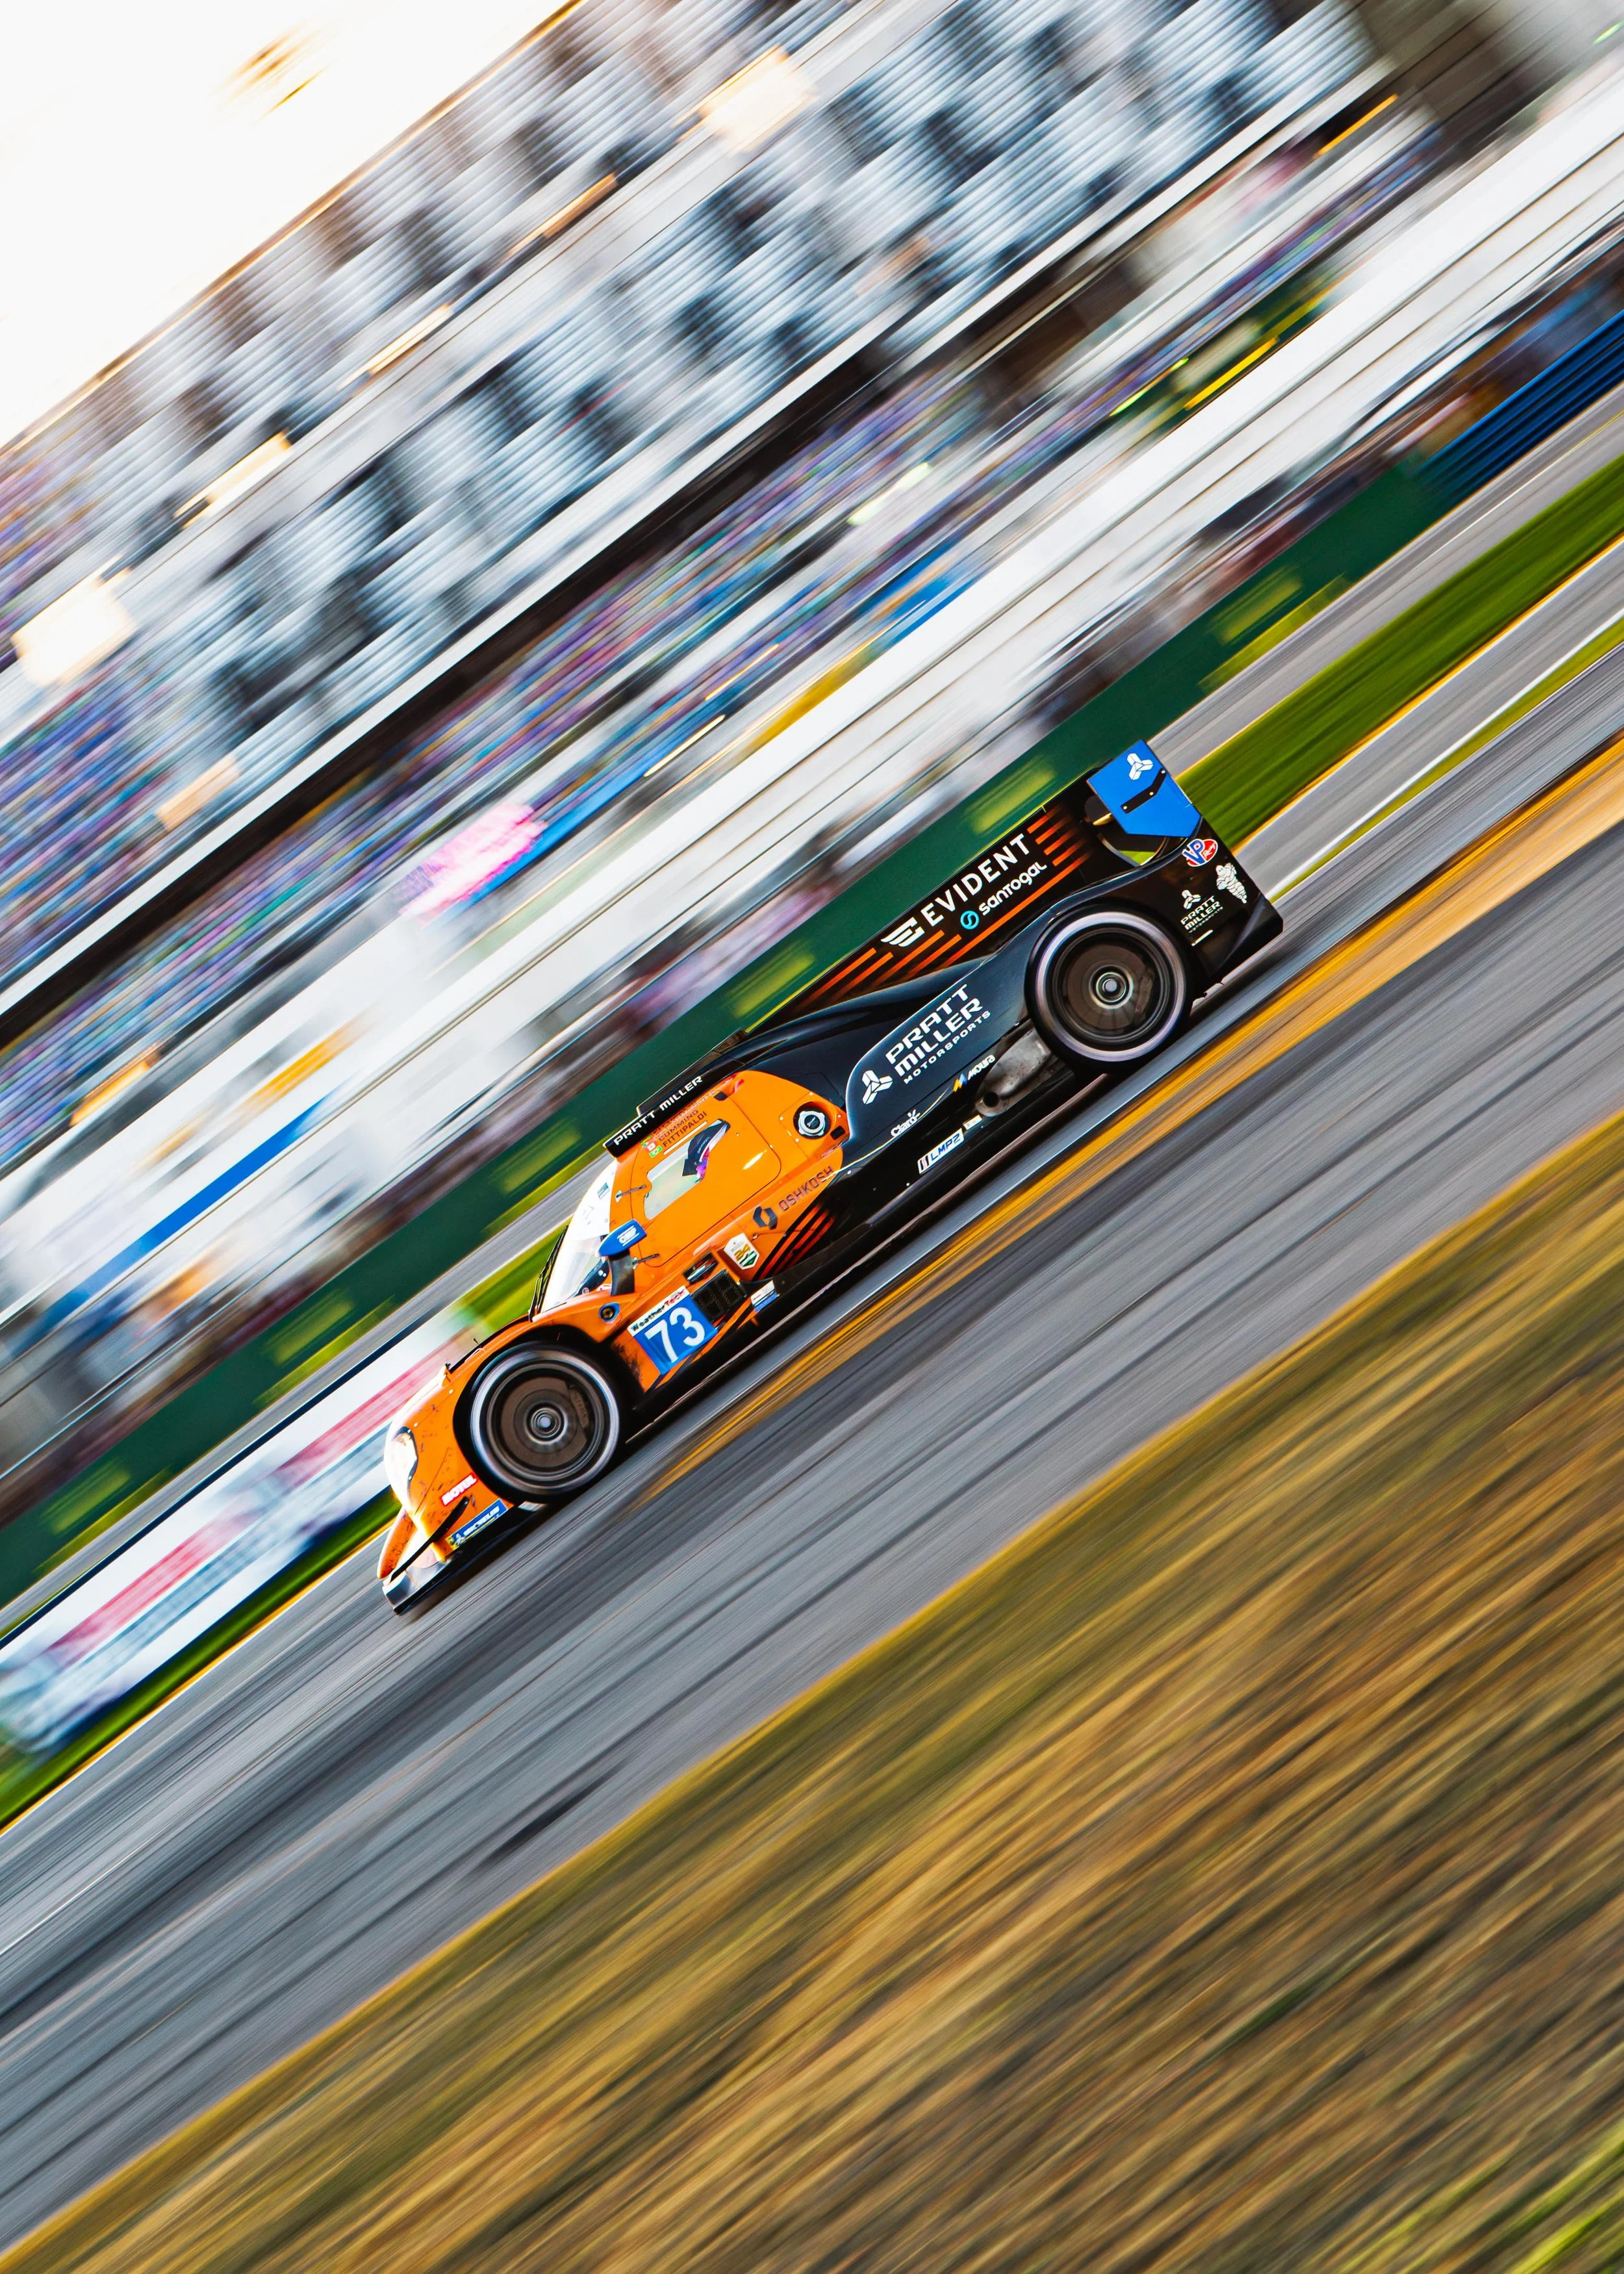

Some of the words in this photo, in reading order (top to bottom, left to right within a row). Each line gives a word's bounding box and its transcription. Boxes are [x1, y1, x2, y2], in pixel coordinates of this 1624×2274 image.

[1182, 839, 1206, 865] VP
[920, 833, 1030, 926] EVIDENT
[978, 862, 1047, 916] santogal
[1180, 895, 1215, 925] PRATT
[1184, 901, 1221, 930] MILLER
[885, 984, 969, 1064] PRATT
[894, 998, 983, 1077] MILLER
[904, 1010, 991, 1084] MOTORSPORTS
[613, 1110, 655, 1145] PRATT
[659, 1076, 703, 1111] MILLER
[659, 1110, 699, 1142] CUMMING
[663, 1111, 707, 1147] FITTIPALDI
[891, 1113, 919, 1137] Claro
[930, 1133, 960, 1161] LMP2
[779, 1166, 833, 1211] OSHKOSH
[644, 1307, 705, 1363] 73
